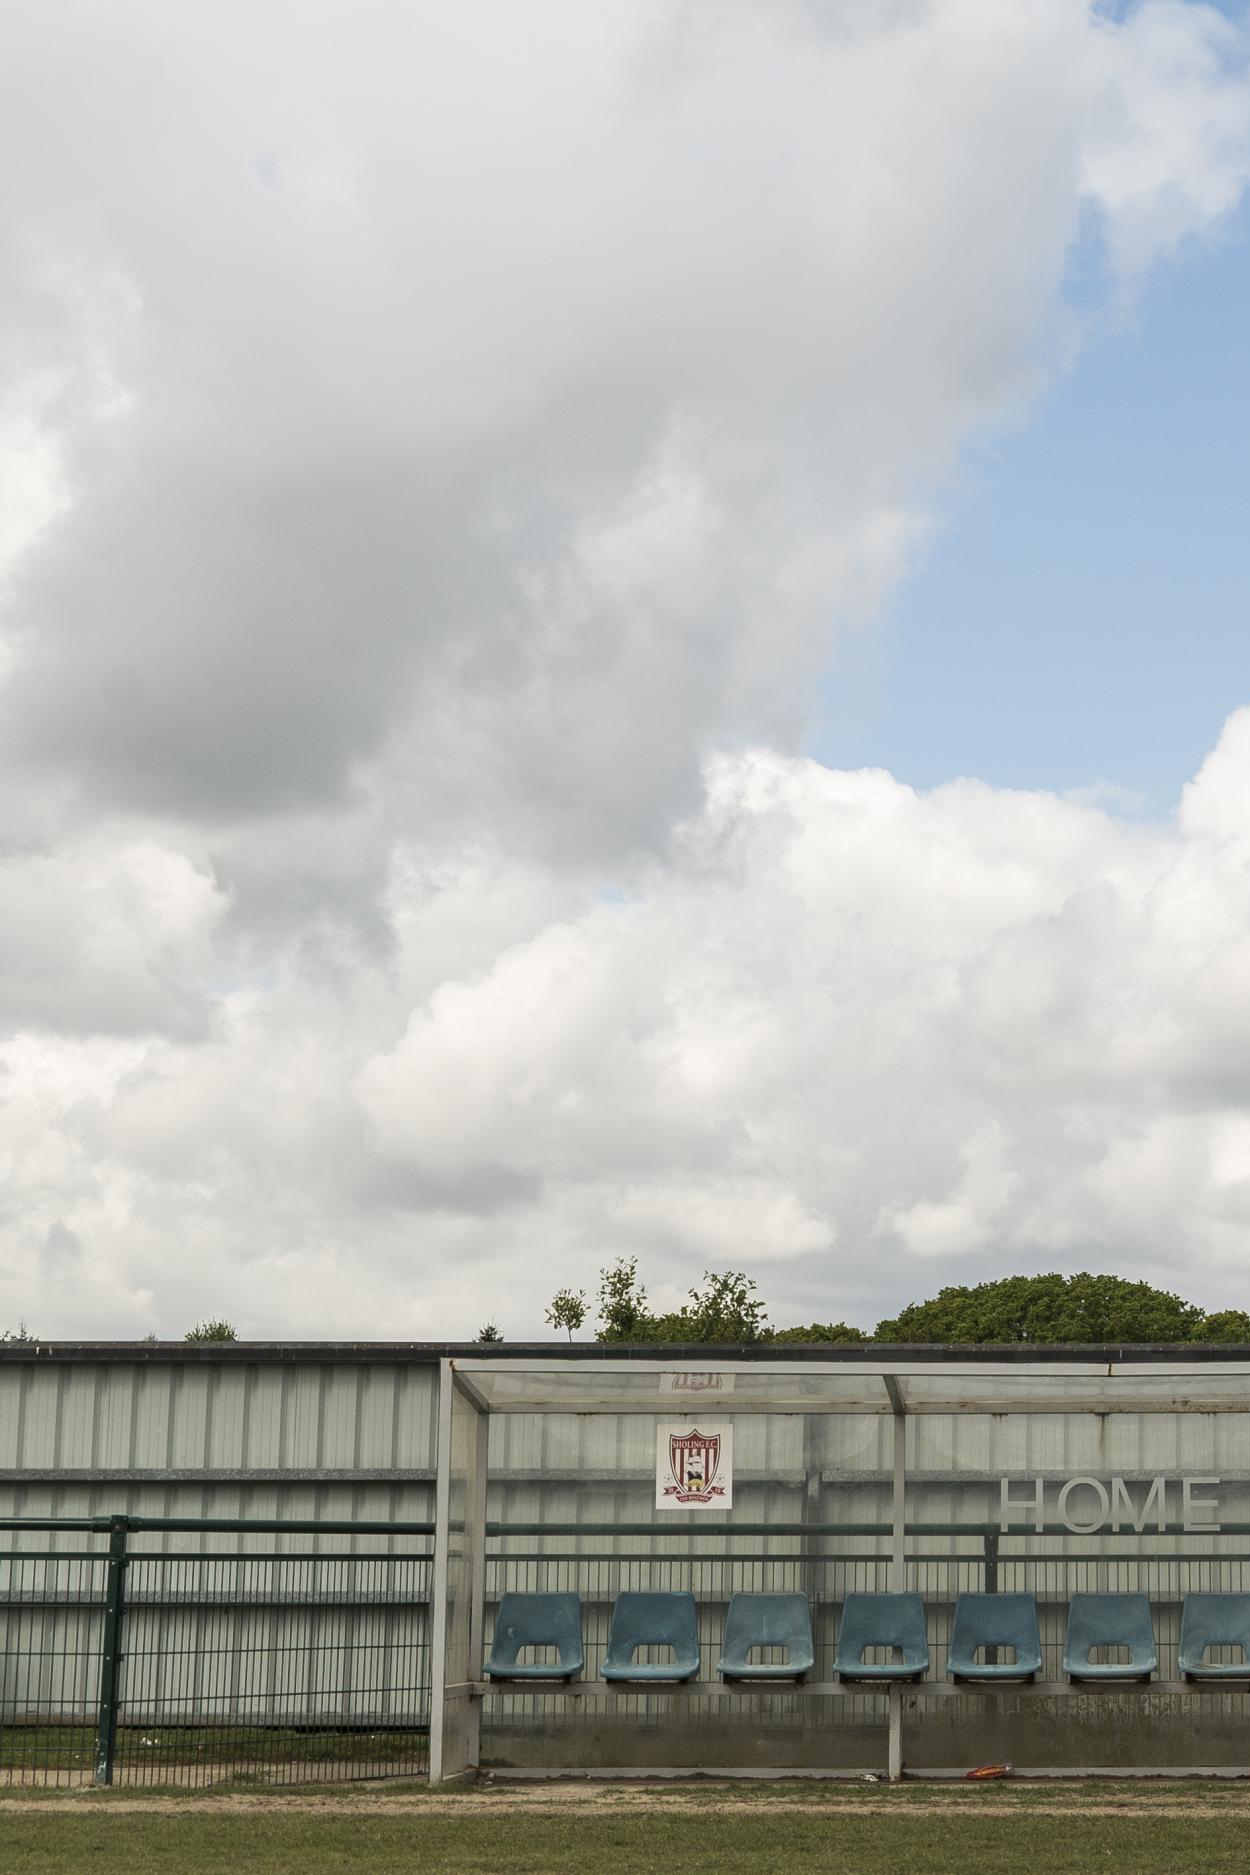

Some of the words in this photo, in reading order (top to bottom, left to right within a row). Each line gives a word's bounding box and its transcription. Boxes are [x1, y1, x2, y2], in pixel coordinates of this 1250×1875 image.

[672, 1440, 705, 1449] SHOLING
[706, 1440, 718, 1448] F.C.
[1000, 1477, 1221, 1534] HOME
